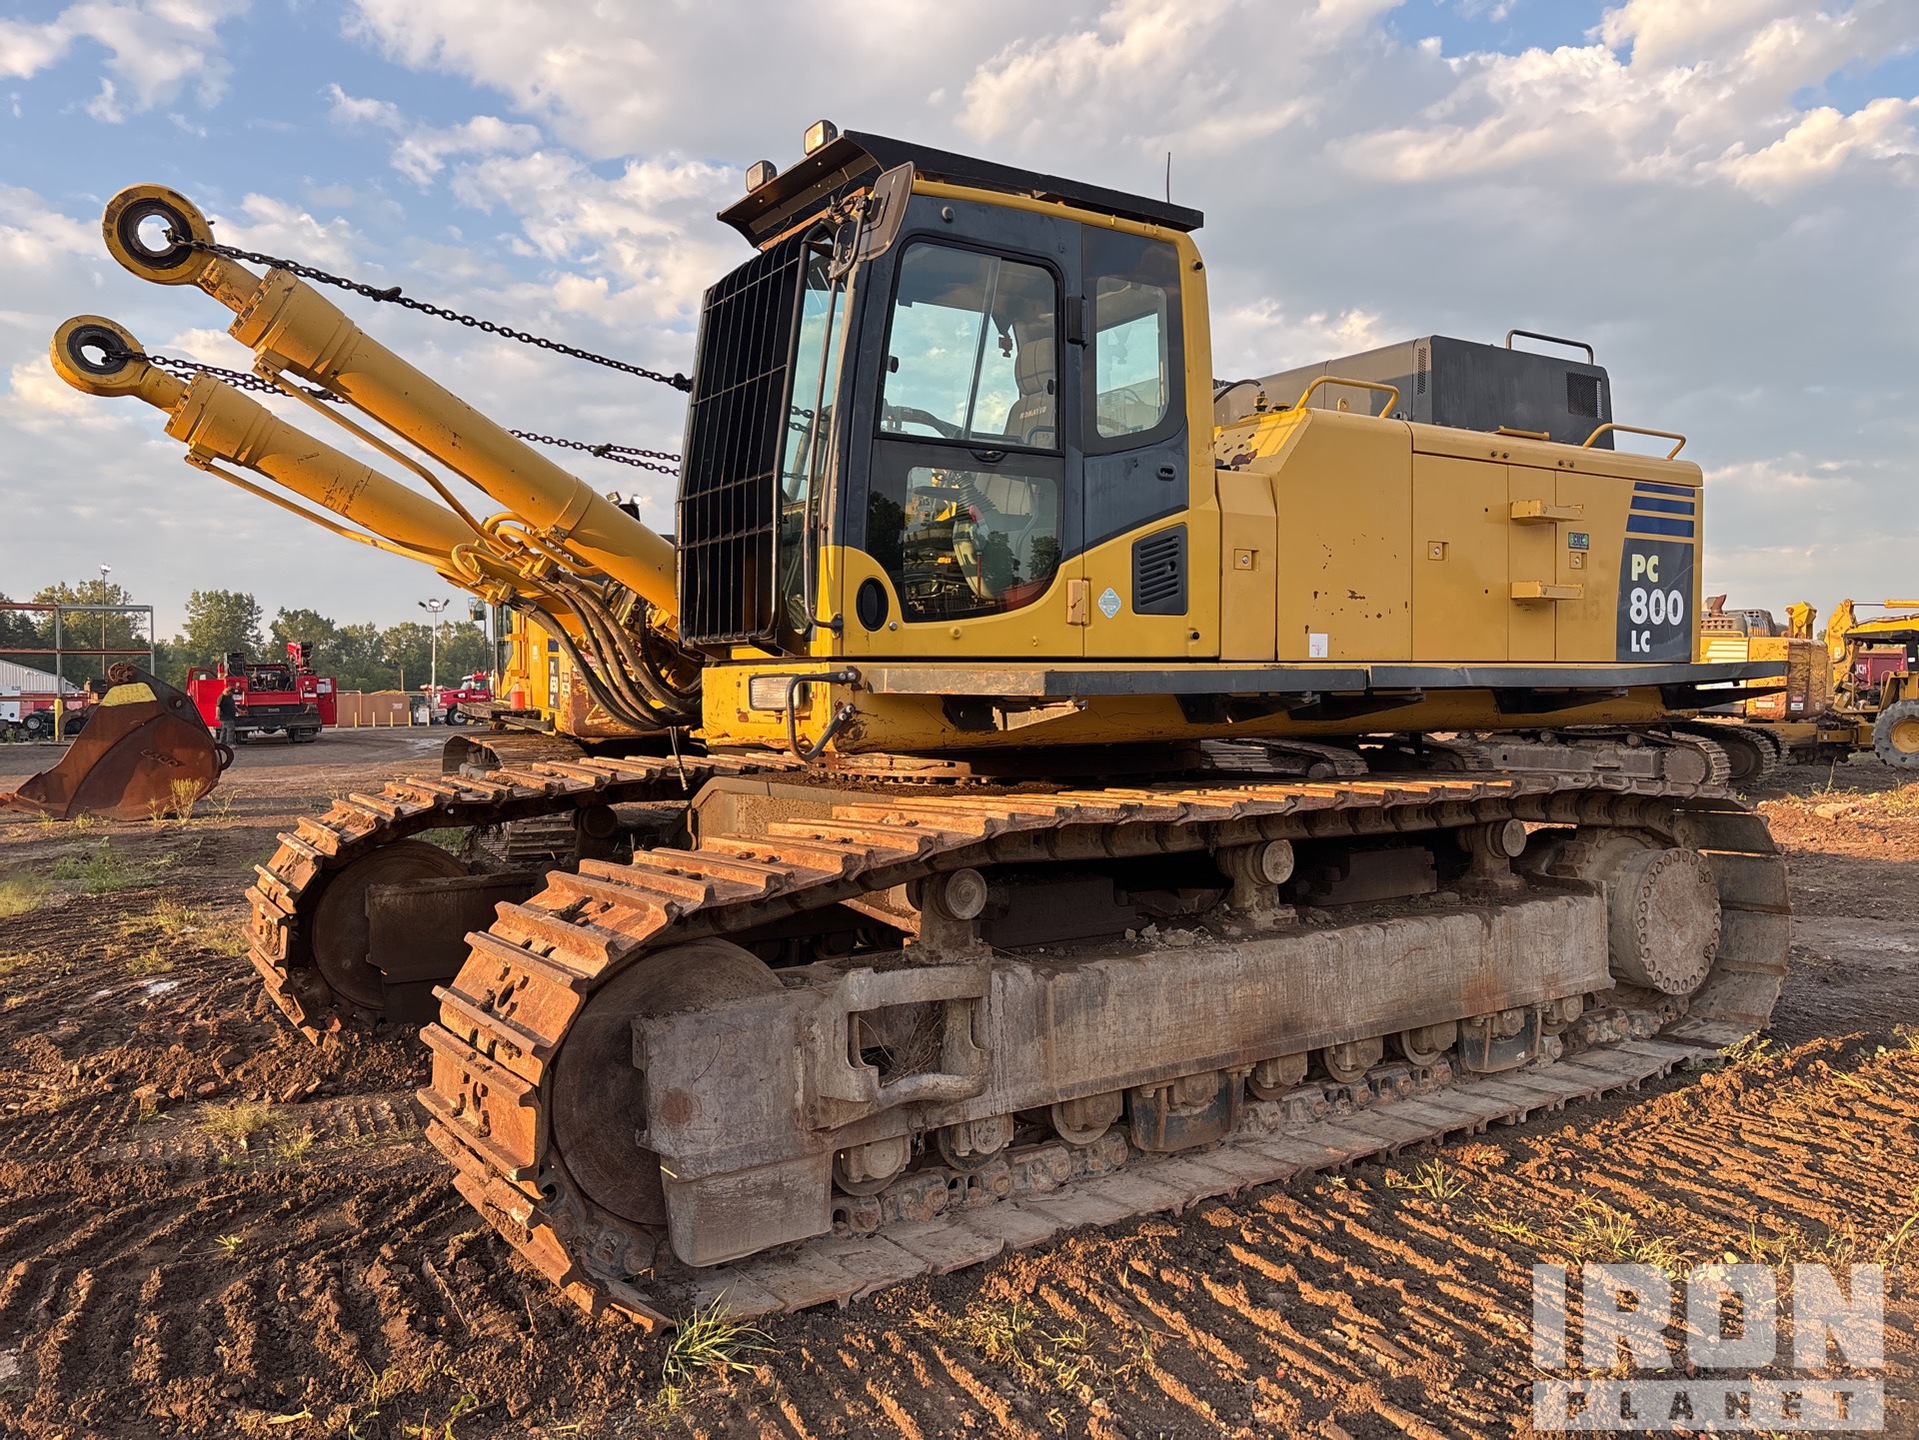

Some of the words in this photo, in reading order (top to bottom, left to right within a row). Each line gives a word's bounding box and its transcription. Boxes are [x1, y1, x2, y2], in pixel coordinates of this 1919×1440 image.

[1631, 554, 1659, 583] PC
[1629, 587, 1684, 626] 800
[1631, 630, 1651, 653] LC
